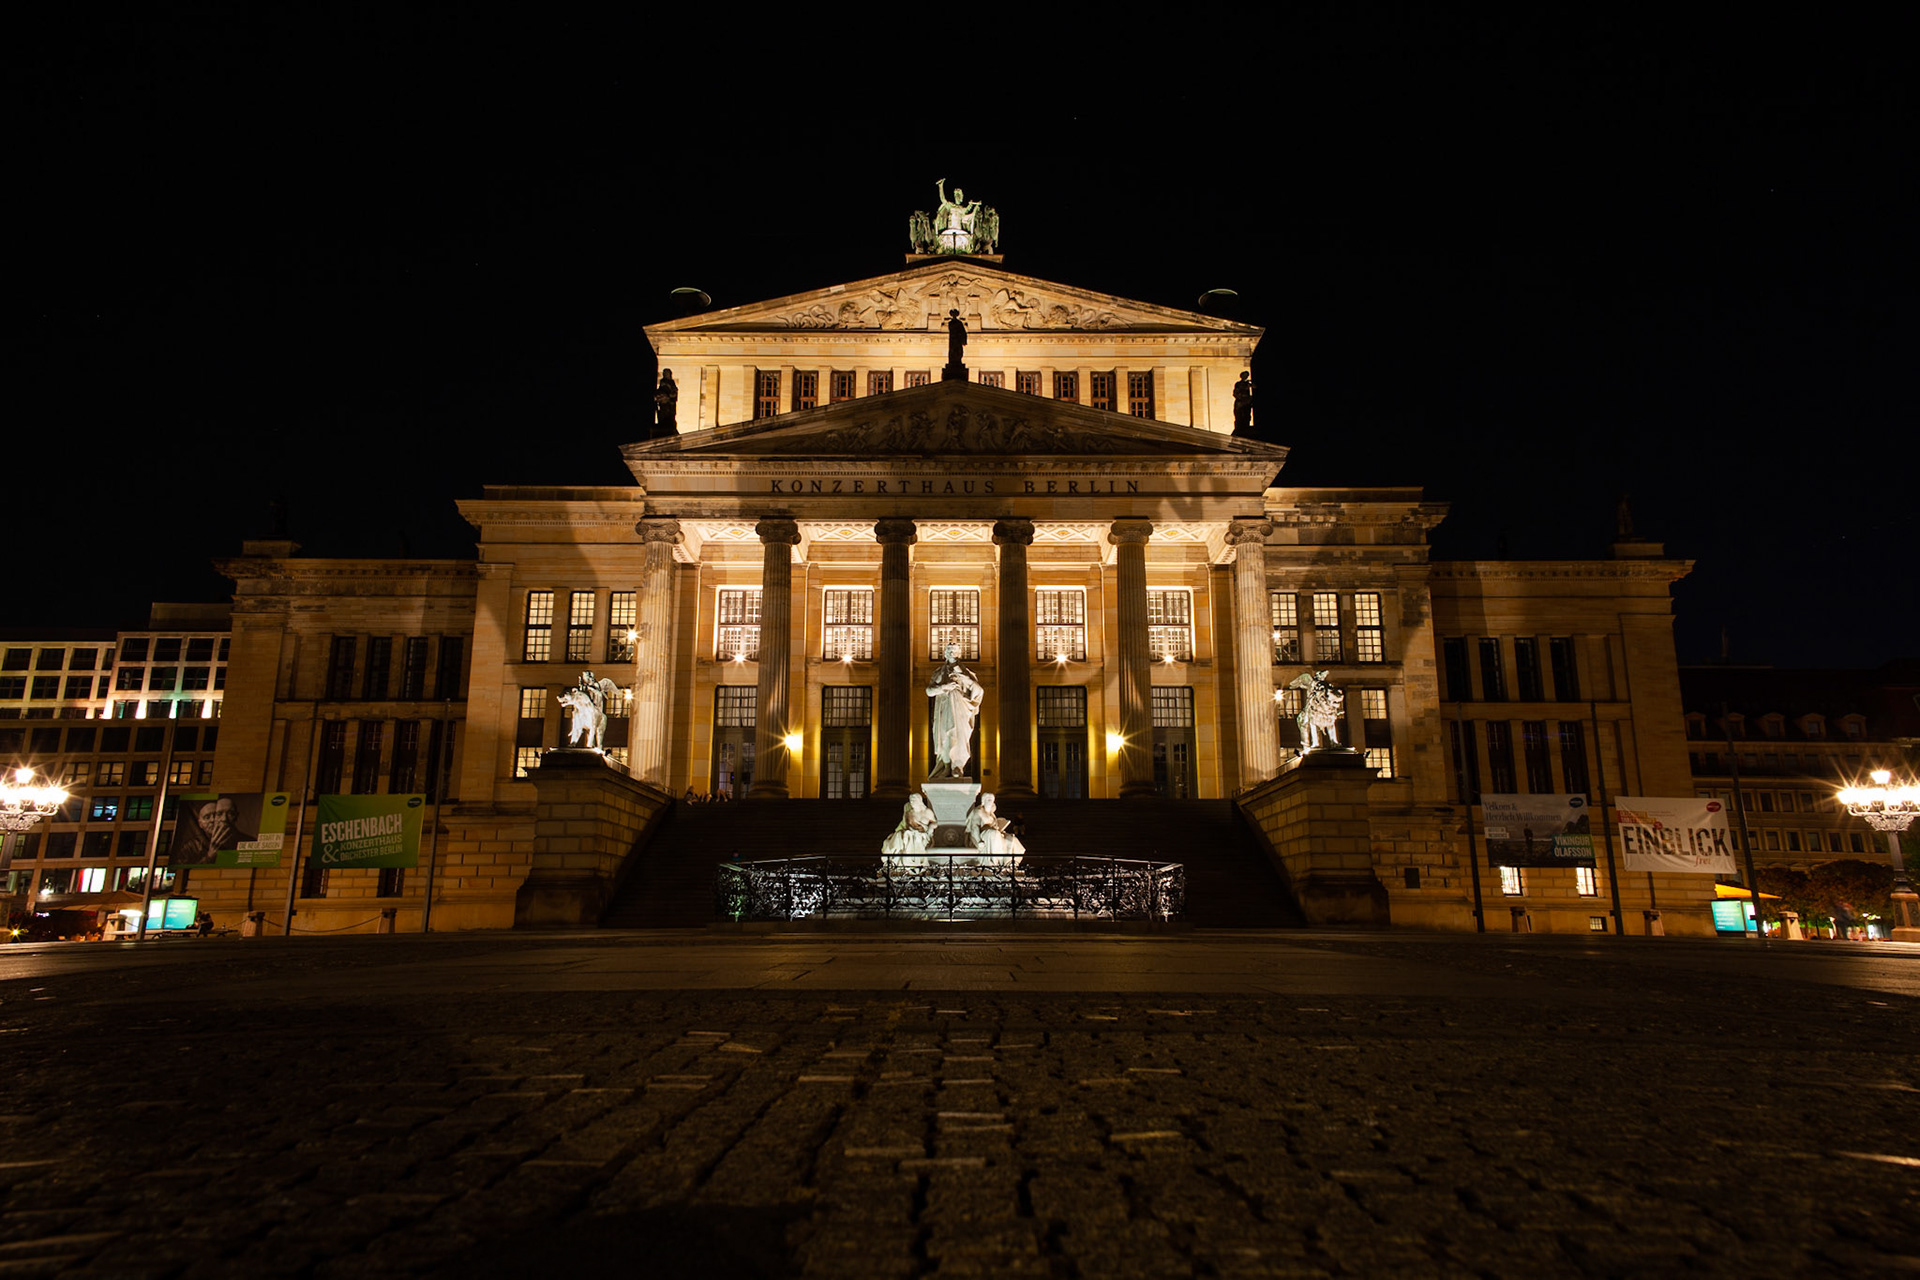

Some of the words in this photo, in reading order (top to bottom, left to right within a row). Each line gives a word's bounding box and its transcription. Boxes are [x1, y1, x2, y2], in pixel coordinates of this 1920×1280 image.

[771, 479, 994, 494] KONZERTHAUS
[1023, 480, 1138, 494] BERLIN
[321, 813, 402, 844] ESCHENBACH
[321, 843, 339, 863] &
[339, 834, 403, 851] KONZERTHAUS
[339, 847, 379, 862] ORCHESTER
[379, 844, 403, 856] BERLIN
[1622, 826, 1731, 857] EINBLICK
[1694, 856, 1711, 867] frei
